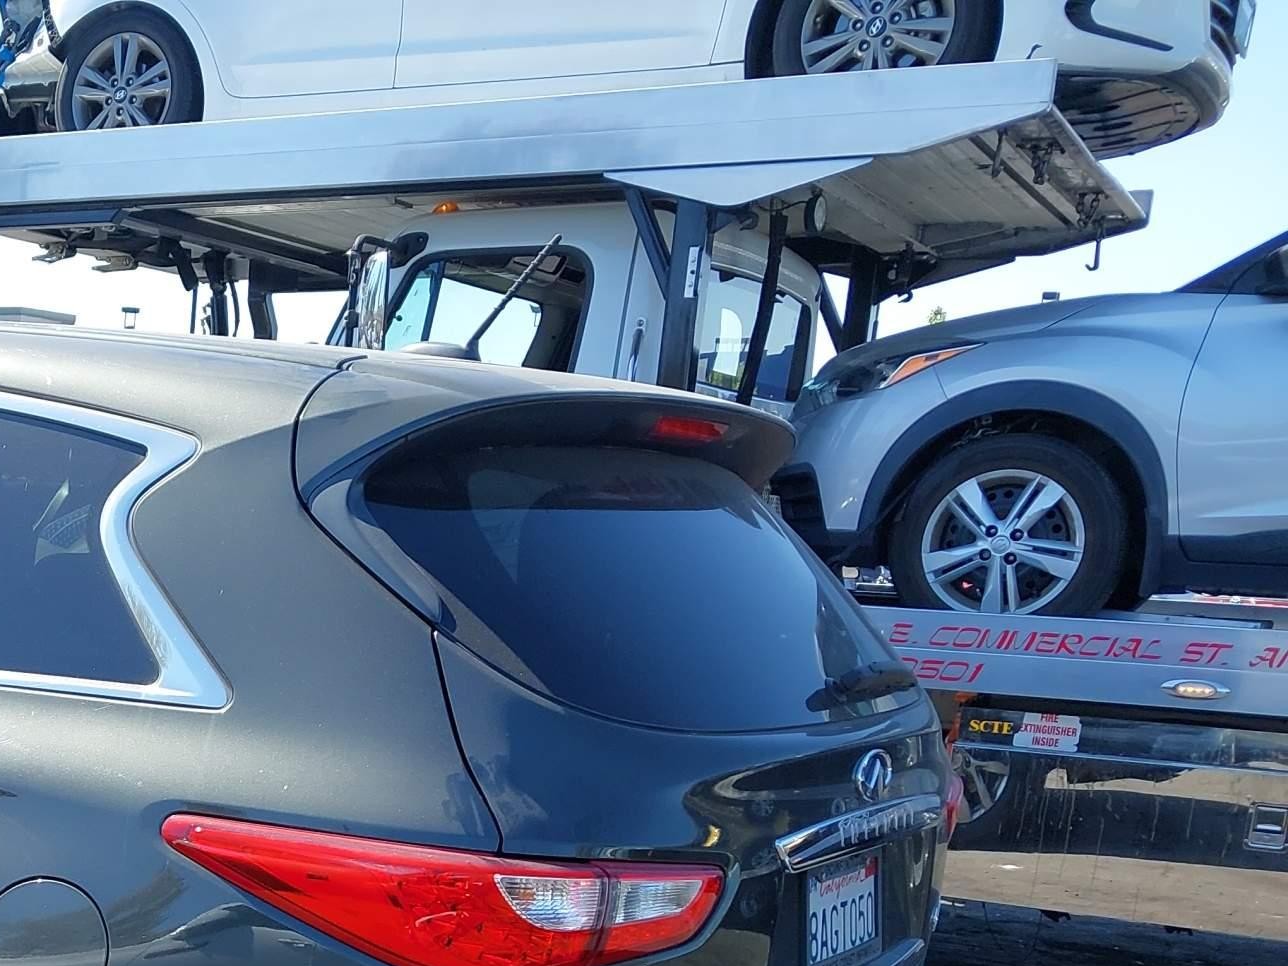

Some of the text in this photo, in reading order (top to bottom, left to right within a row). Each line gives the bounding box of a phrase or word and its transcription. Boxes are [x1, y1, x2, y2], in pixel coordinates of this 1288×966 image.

[889, 623, 918, 644] E.
[929, 626, 1161, 660] COMMERCIAL
[1179, 642, 1234, 666] ST.
[968, 720, 1014, 735] SCTE
[1032, 736, 1060, 748] INSIDE
[809, 890, 874, 964] 8AGT050
